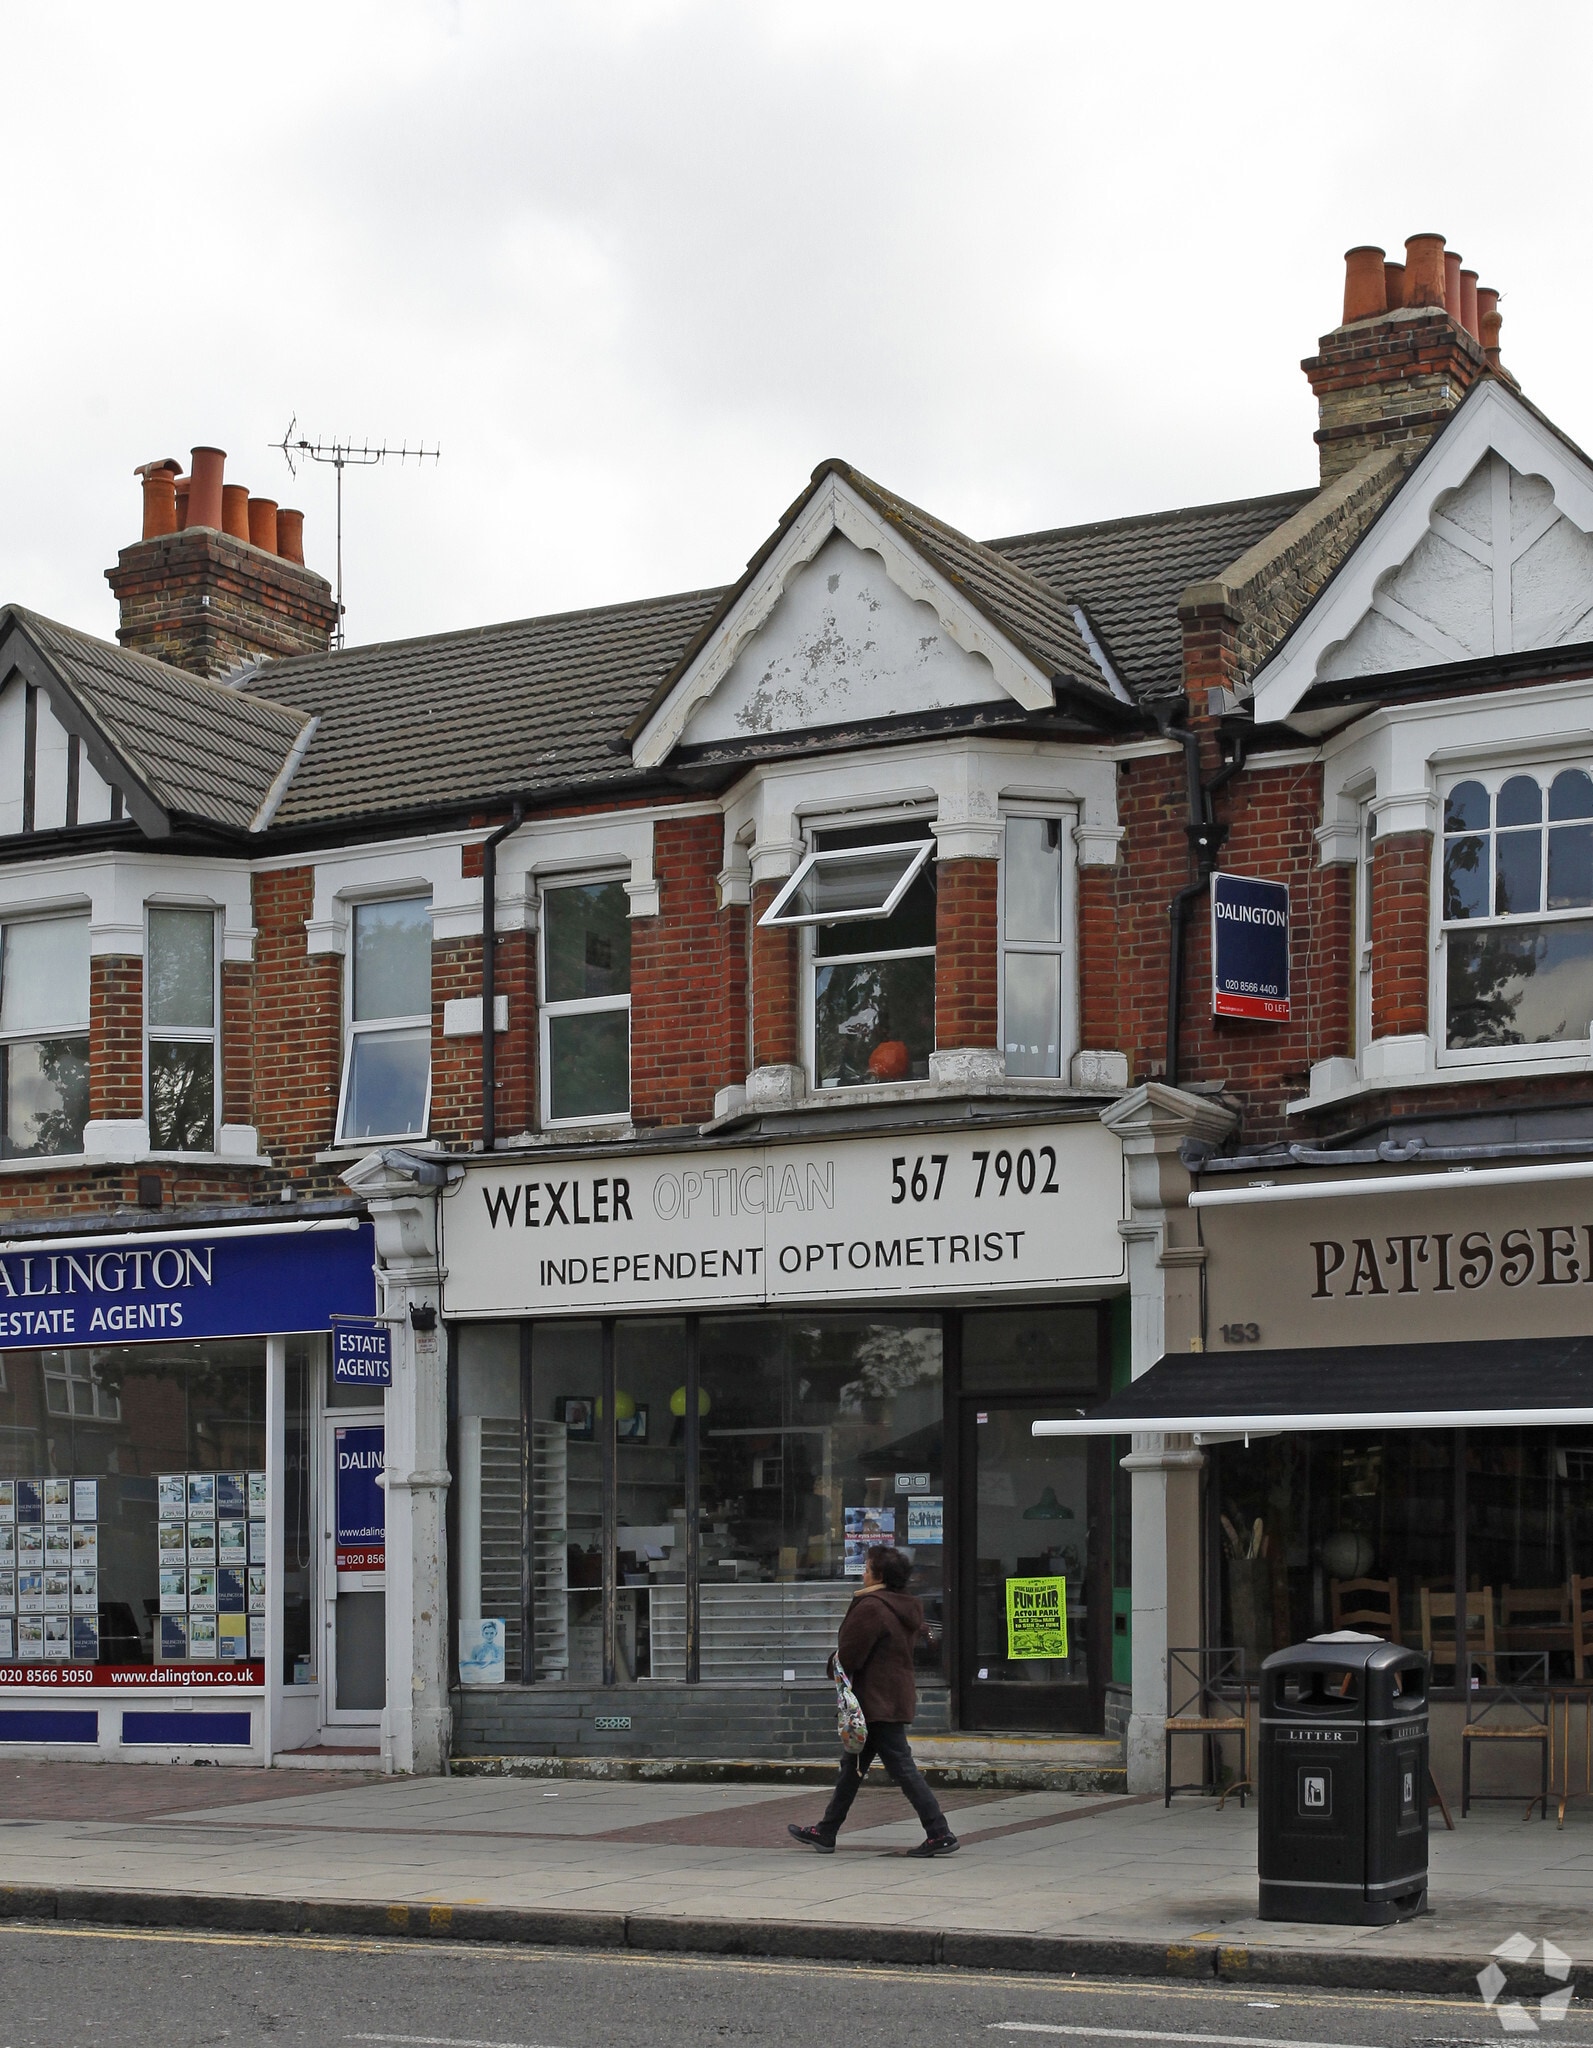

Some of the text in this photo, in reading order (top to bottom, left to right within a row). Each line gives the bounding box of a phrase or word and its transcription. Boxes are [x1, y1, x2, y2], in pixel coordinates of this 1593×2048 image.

[1216, 901, 1286, 928] DALINGTON
[1225, 979, 1278, 995] 020 8566 4400
[1264, 1003, 1286, 1013] TO LET
[891, 1145, 1059, 1204] 567 7902
[482, 1161, 835, 1229] WEXLER OPTICIAN
[540, 1231, 1026, 1286] INDEPENDENT OPTOMETRIST
[0, 1302, 183, 1336] ESTATE AGENTS
[1219, 1322, 1261, 1345] 153
[339, 1333, 386, 1354] ESTATE
[336, 1358, 390, 1378] AGENTS
[339, 1451, 386, 1469] DALIN
[346, 1555, 365, 1564] 020
[1013, 1590, 1059, 1609] FUN FAIR
[0, 1669, 93, 1683] 020 8566 5050
[111, 1668, 254, 1685] www.dalington.co.uk
[1289, 1731, 1343, 1741] LITTER
